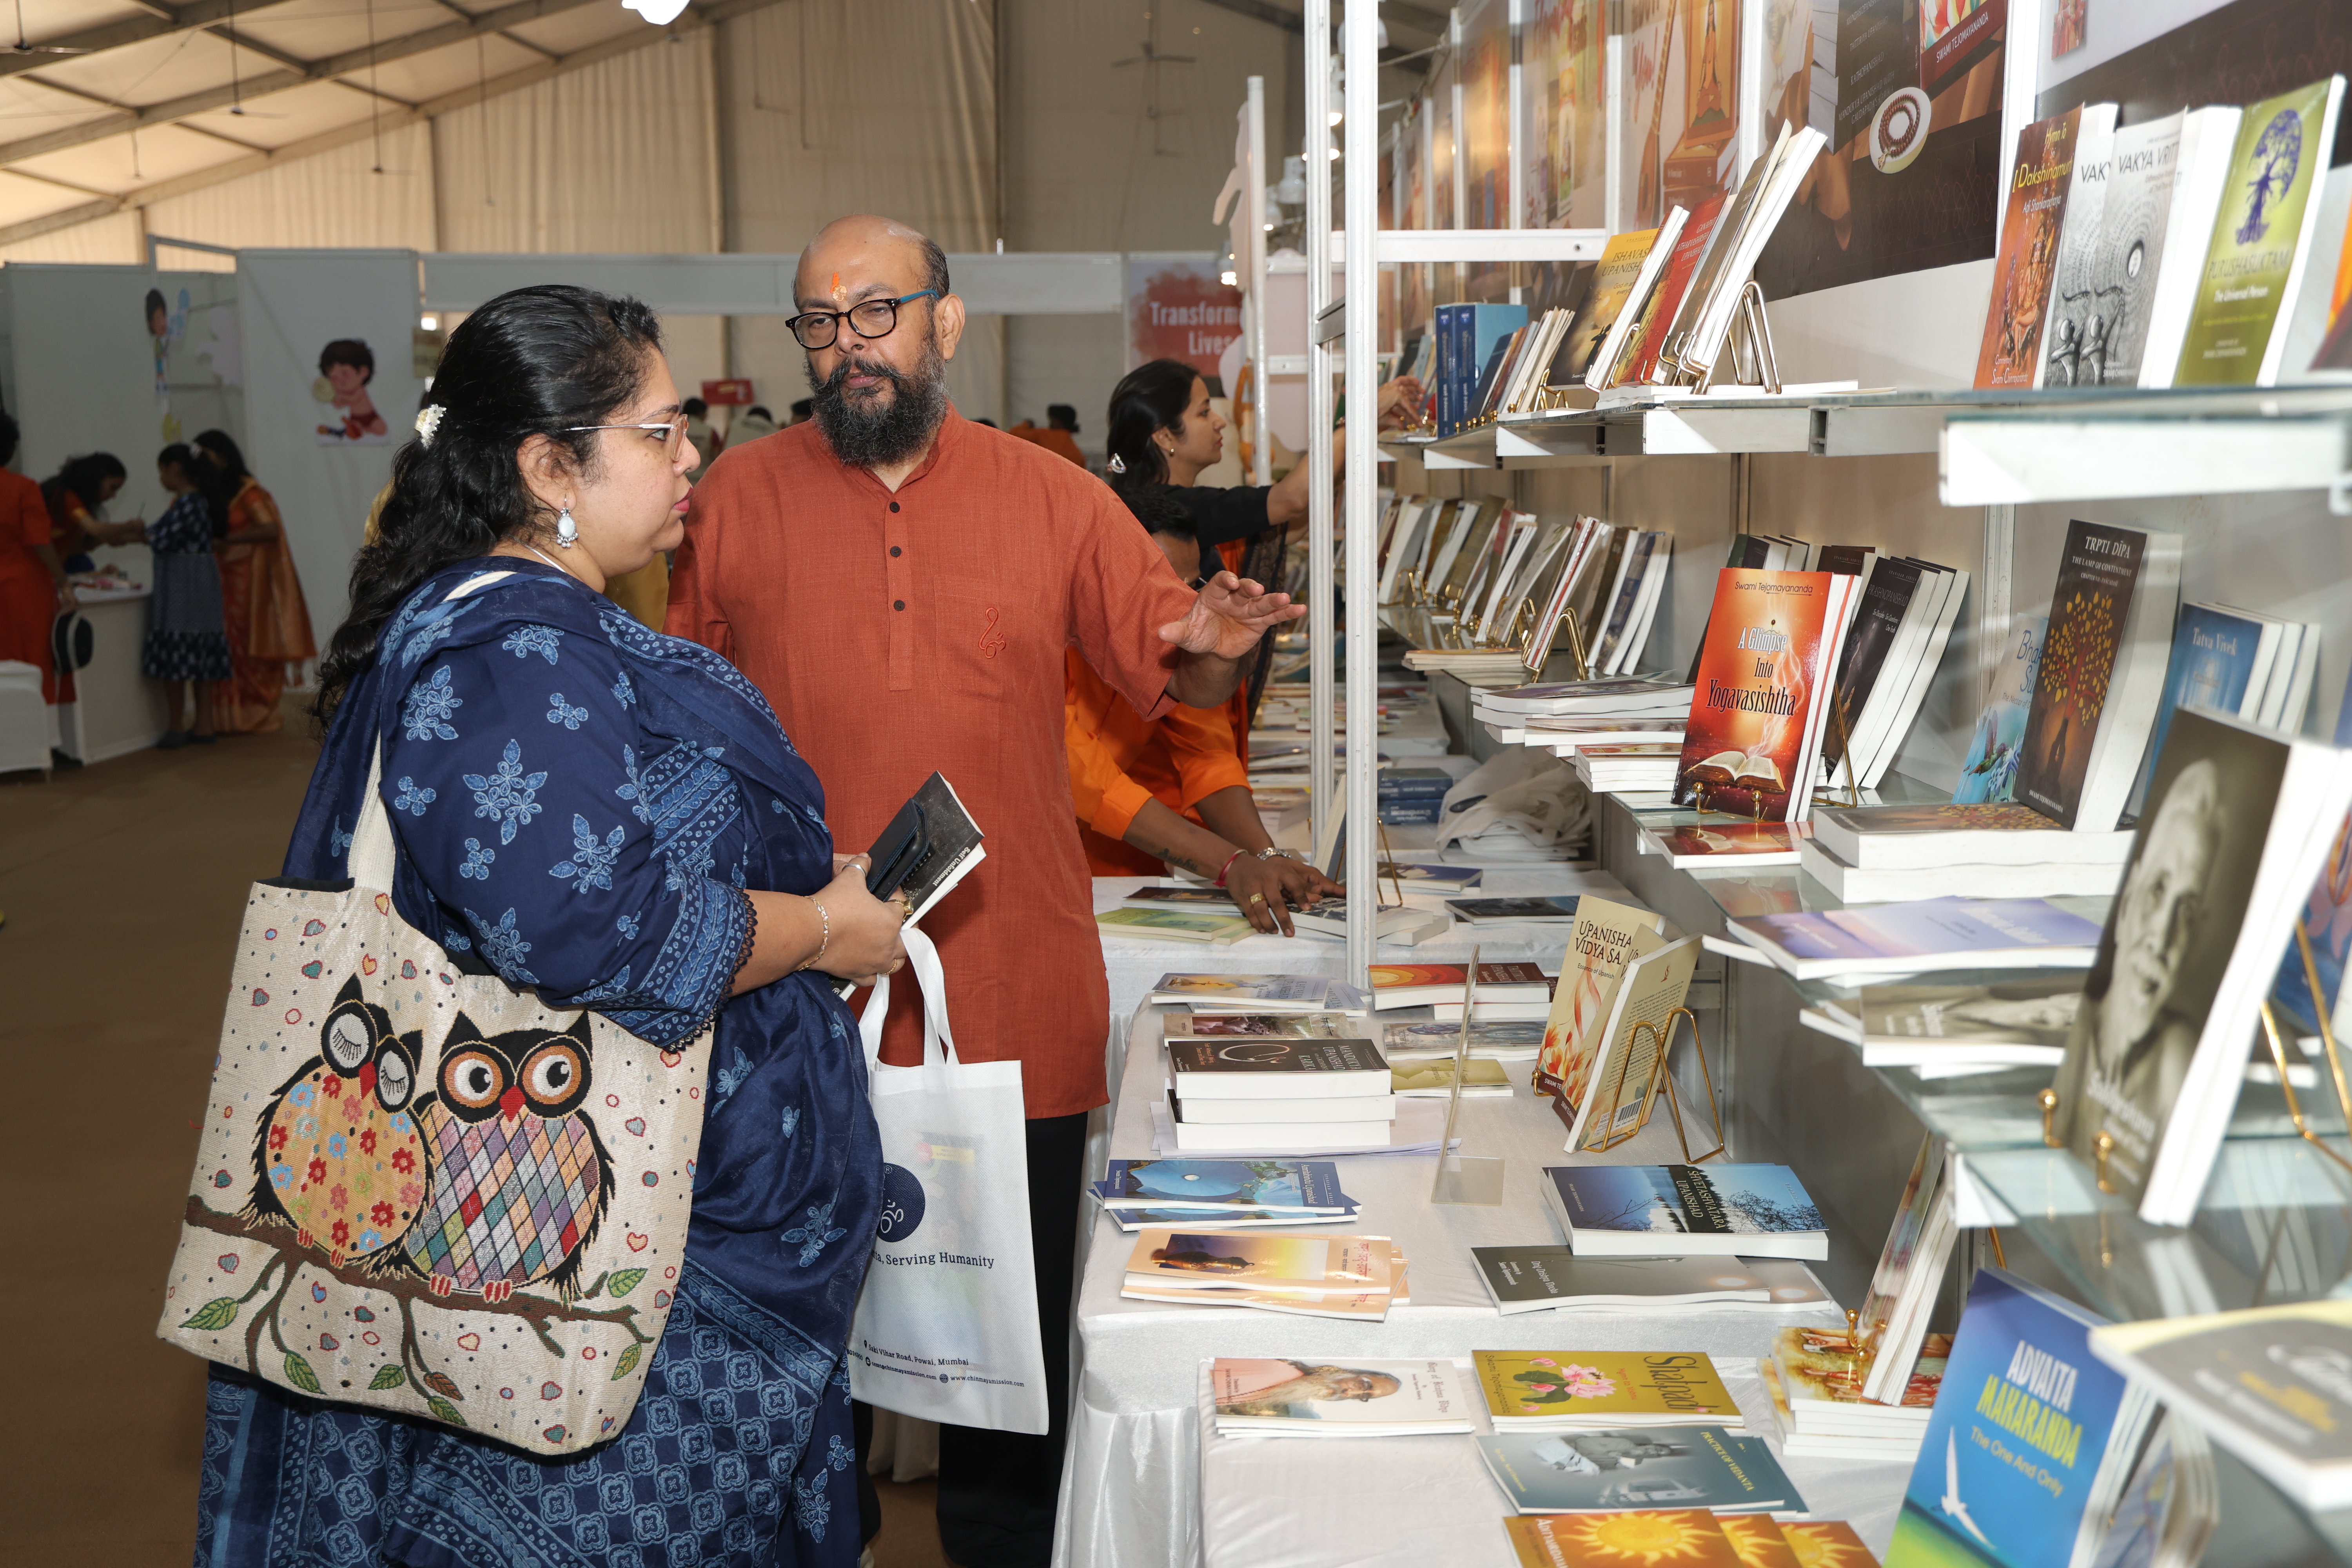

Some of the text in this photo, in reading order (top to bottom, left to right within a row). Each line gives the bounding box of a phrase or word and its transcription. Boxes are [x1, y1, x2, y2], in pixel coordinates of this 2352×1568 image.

[1936, 44, 1951, 63] SWAMI
[1951, 12, 1988, 49] TEJOMAYANANDA
[1851, 51, 1884, 86] KATHOPANISHAD
[2045, 122, 2067, 149] Hymn To
[2119, 150, 2152, 174] VAKYA
[1612, 248, 1649, 263] ISHAVAS
[1189, 331, 1234, 356] Lives
[1992, 368, 2028, 385] Swami Chinmayananda
[2072, 556, 2082, 565] THE
[2082, 558, 2095, 568] LAMP
[2102, 563, 2132, 577] CONTENTMENT
[2081, 572, 2095, 581] CHAPTER
[1735, 581, 1813, 593] Swami Tejomayananda
[1867, 584, 1908, 606] PRASHNOPANISHAD
[1876, 610, 1884, 619] Disciples
[1737, 626, 1788, 655] A Glimpse
[1754, 657, 1773, 678] Into
[1706, 679, 1797, 717] Yogavasishtha
[2009, 695, 2022, 706] Nectar
[2029, 789, 2063, 813] SWAMI TEJOMAYANANDA
[1579, 920, 1632, 948] UPANISHA
[1576, 936, 1623, 965] VIDYA SA
[1577, 963, 1593, 973] Essence
[1599, 970, 1614, 980] Upanish
[1292, 981, 1307, 999] KAIVALYA
[1298, 1055, 1316, 1070] KARIKA
[1323, 1047, 1346, 1070] UPANISHAD
[1338, 1045, 1362, 1069] MANDUKYA
[1544, 1078, 1557, 1087] SWAMI
[1301, 1164, 1318, 1204] Amritabindu Upanishad
[1676, 1180, 1704, 1218] UPANISHAD
[1688, 1170, 1725, 1229] SHVETASHVATARA
[886, 1252, 995, 1269] Serving Humanity
[868, 1344, 879, 1354] Saki
[879, 1348, 895, 1358] Vihar
[896, 1352, 914, 1363] Road,
[914, 1356, 936, 1366] Powai,
[951, 1376, 1024, 1387] www.chinmayamission.com
[1485, 1355, 1510, 1414] Swami Tejomayananda
[1640, 1356, 1721, 1413] Shatpadi
[2006, 1339, 2078, 1414] ADVAITA
[1976, 1374, 2083, 1469] MAKARANDA
[1700, 1432, 1755, 1491] PRACTICE OF VEDANTA
[1971, 1425, 2064, 1497] The One And Only
